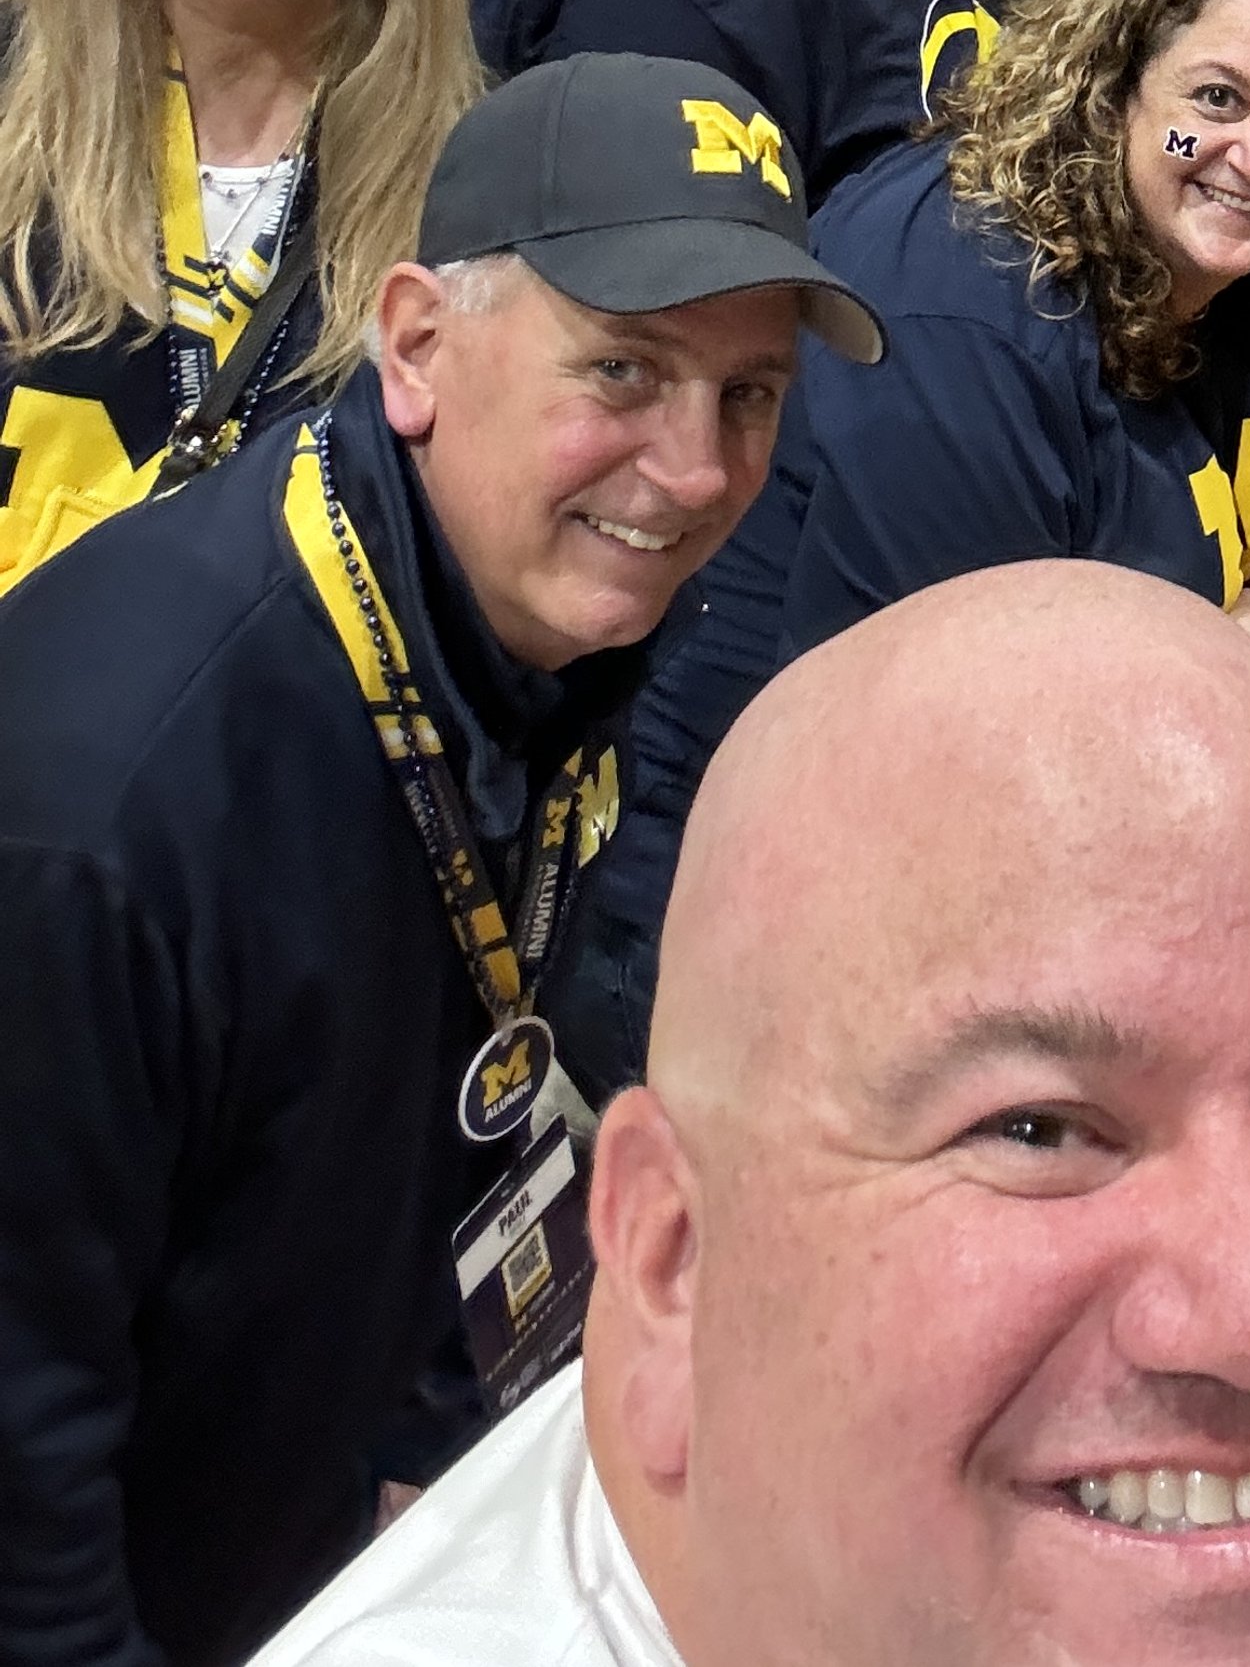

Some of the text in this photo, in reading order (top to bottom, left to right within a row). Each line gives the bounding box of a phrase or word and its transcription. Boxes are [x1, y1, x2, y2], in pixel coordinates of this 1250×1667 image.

[681, 99, 792, 198] M
[1165, 129, 1198, 159] M
[524, 863, 560, 959] ALUMNI
[480, 1038, 532, 1109] M
[484, 1078, 532, 1124] ALUMNI
